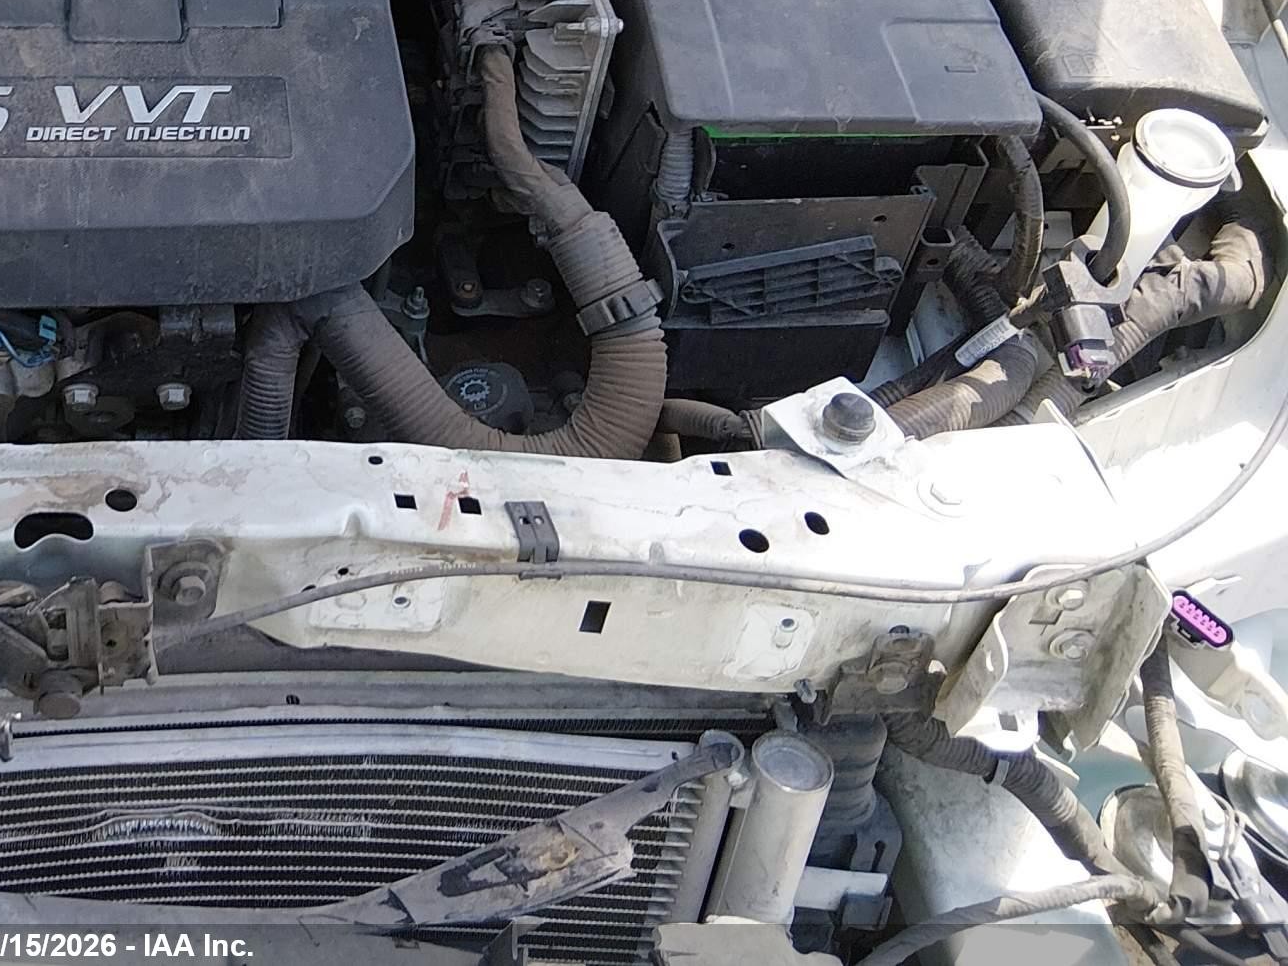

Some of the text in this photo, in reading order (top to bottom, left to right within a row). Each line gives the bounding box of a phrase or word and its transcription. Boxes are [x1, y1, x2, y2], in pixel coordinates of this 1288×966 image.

[54, 85, 233, 124] VVT
[26, 126, 251, 142] DIRECT INJECTION
